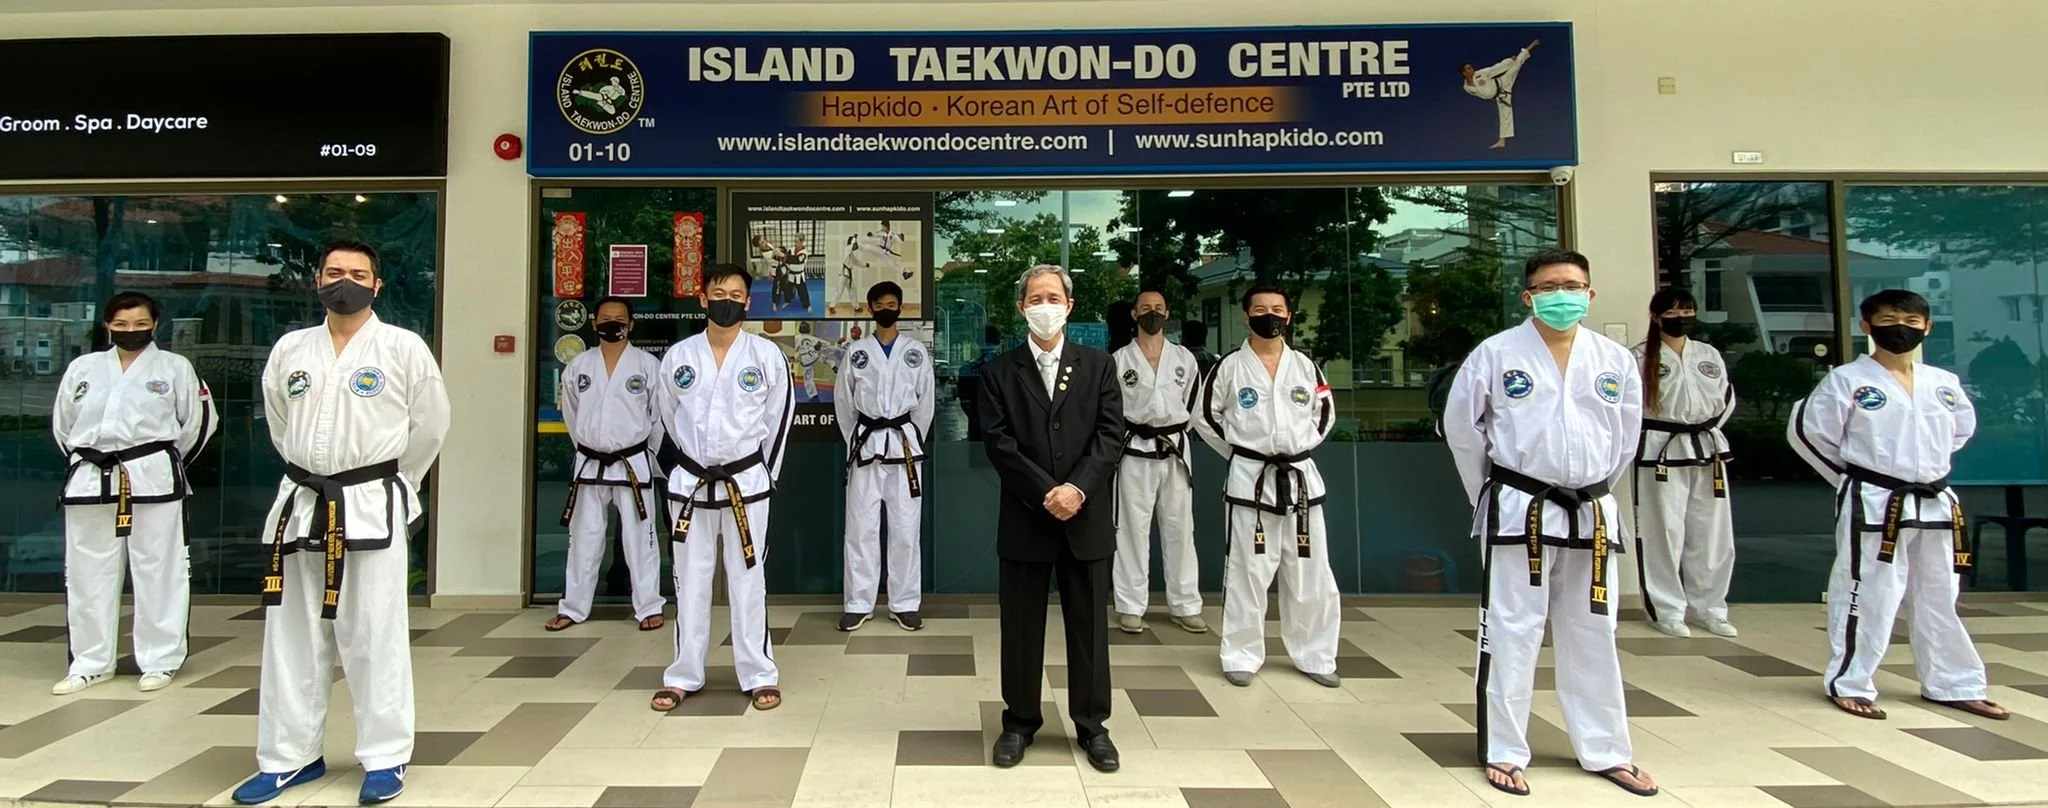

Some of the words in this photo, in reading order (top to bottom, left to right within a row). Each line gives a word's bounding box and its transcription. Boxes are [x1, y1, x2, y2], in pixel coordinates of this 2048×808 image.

[689, 46, 855, 82] ISLAND
[889, 43, 1197, 82] TAEKWON-DO
[1228, 40, 1411, 78] CENTRE
[1342, 81, 1375, 99] PTE
[1379, 81, 1411, 98] LTD
[561, 73, 574, 109] ISLAND
[570, 110, 630, 131] TAEKWON-DO
[627, 71, 641, 109] CENTRE
[822, 95, 922, 122] Hapkido
[947, 95, 1036, 117] Korean
[1042, 94, 1077, 117] Art
[1085, 93, 1109, 116] of
[1117, 91, 1274, 116] Self-defence
[0, 116, 60, 132] Groom
[74, 114, 113, 134] Spa
[126, 114, 208, 133] Daycare
[638, 117, 655, 128] TM
[717, 131, 1088, 152] www.islandtaekwondocentre.com
[1135, 128, 1384, 151] www.sunhapkido.com
[320, 144, 376, 157] #01-09
[569, 142, 631, 162] 01-10
[793, 414, 817, 426] ART
[820, 414, 835, 426] OF
[116, 515, 132, 528] IV
[1954, 552, 1972, 567] IV
[264, 576, 283, 592] III
[324, 589, 339, 606] III
[1592, 585, 1607, 603] IV
[1849, 581, 1860, 614] ITF
[1480, 610, 1489, 650] ITF
